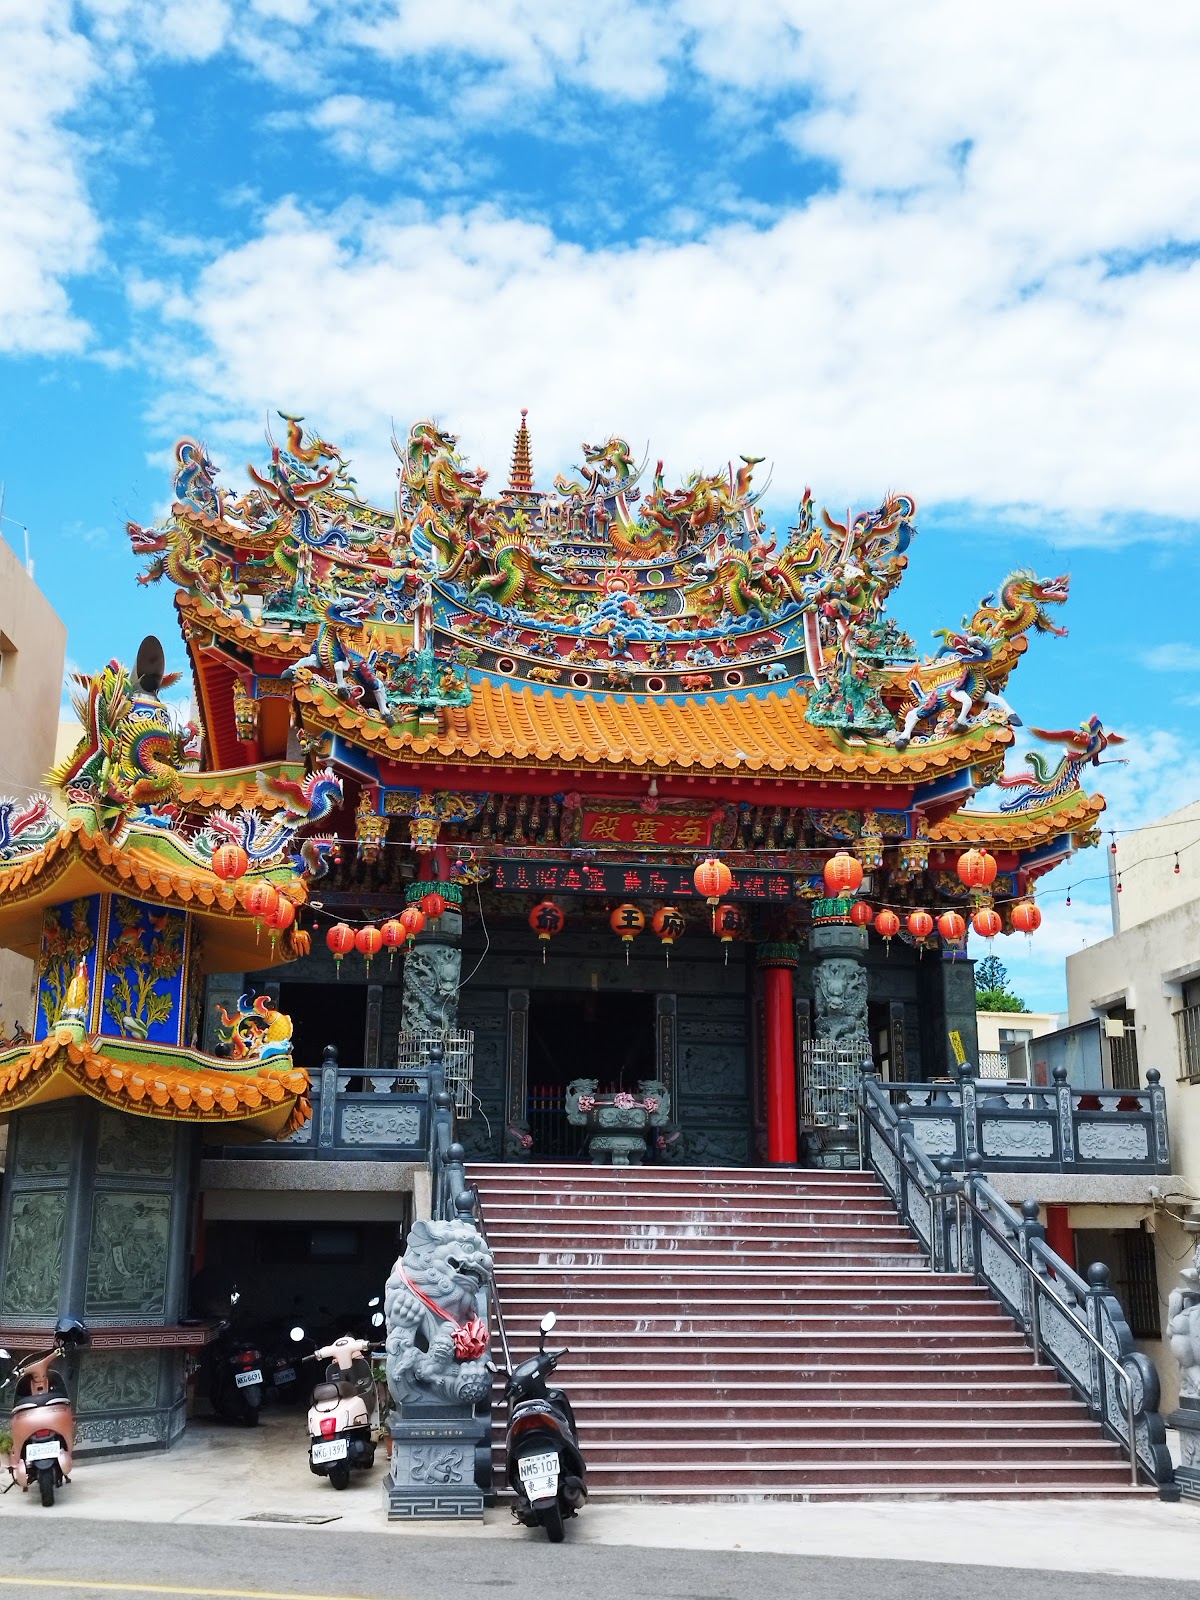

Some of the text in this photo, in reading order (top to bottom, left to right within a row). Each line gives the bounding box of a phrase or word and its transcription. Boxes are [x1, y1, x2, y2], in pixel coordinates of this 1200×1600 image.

[535, 907, 560, 932] 爺
[616, 909, 642, 931] 王
[659, 912, 684, 935] 府
[520, 1458, 558, 1477] NM5-107
